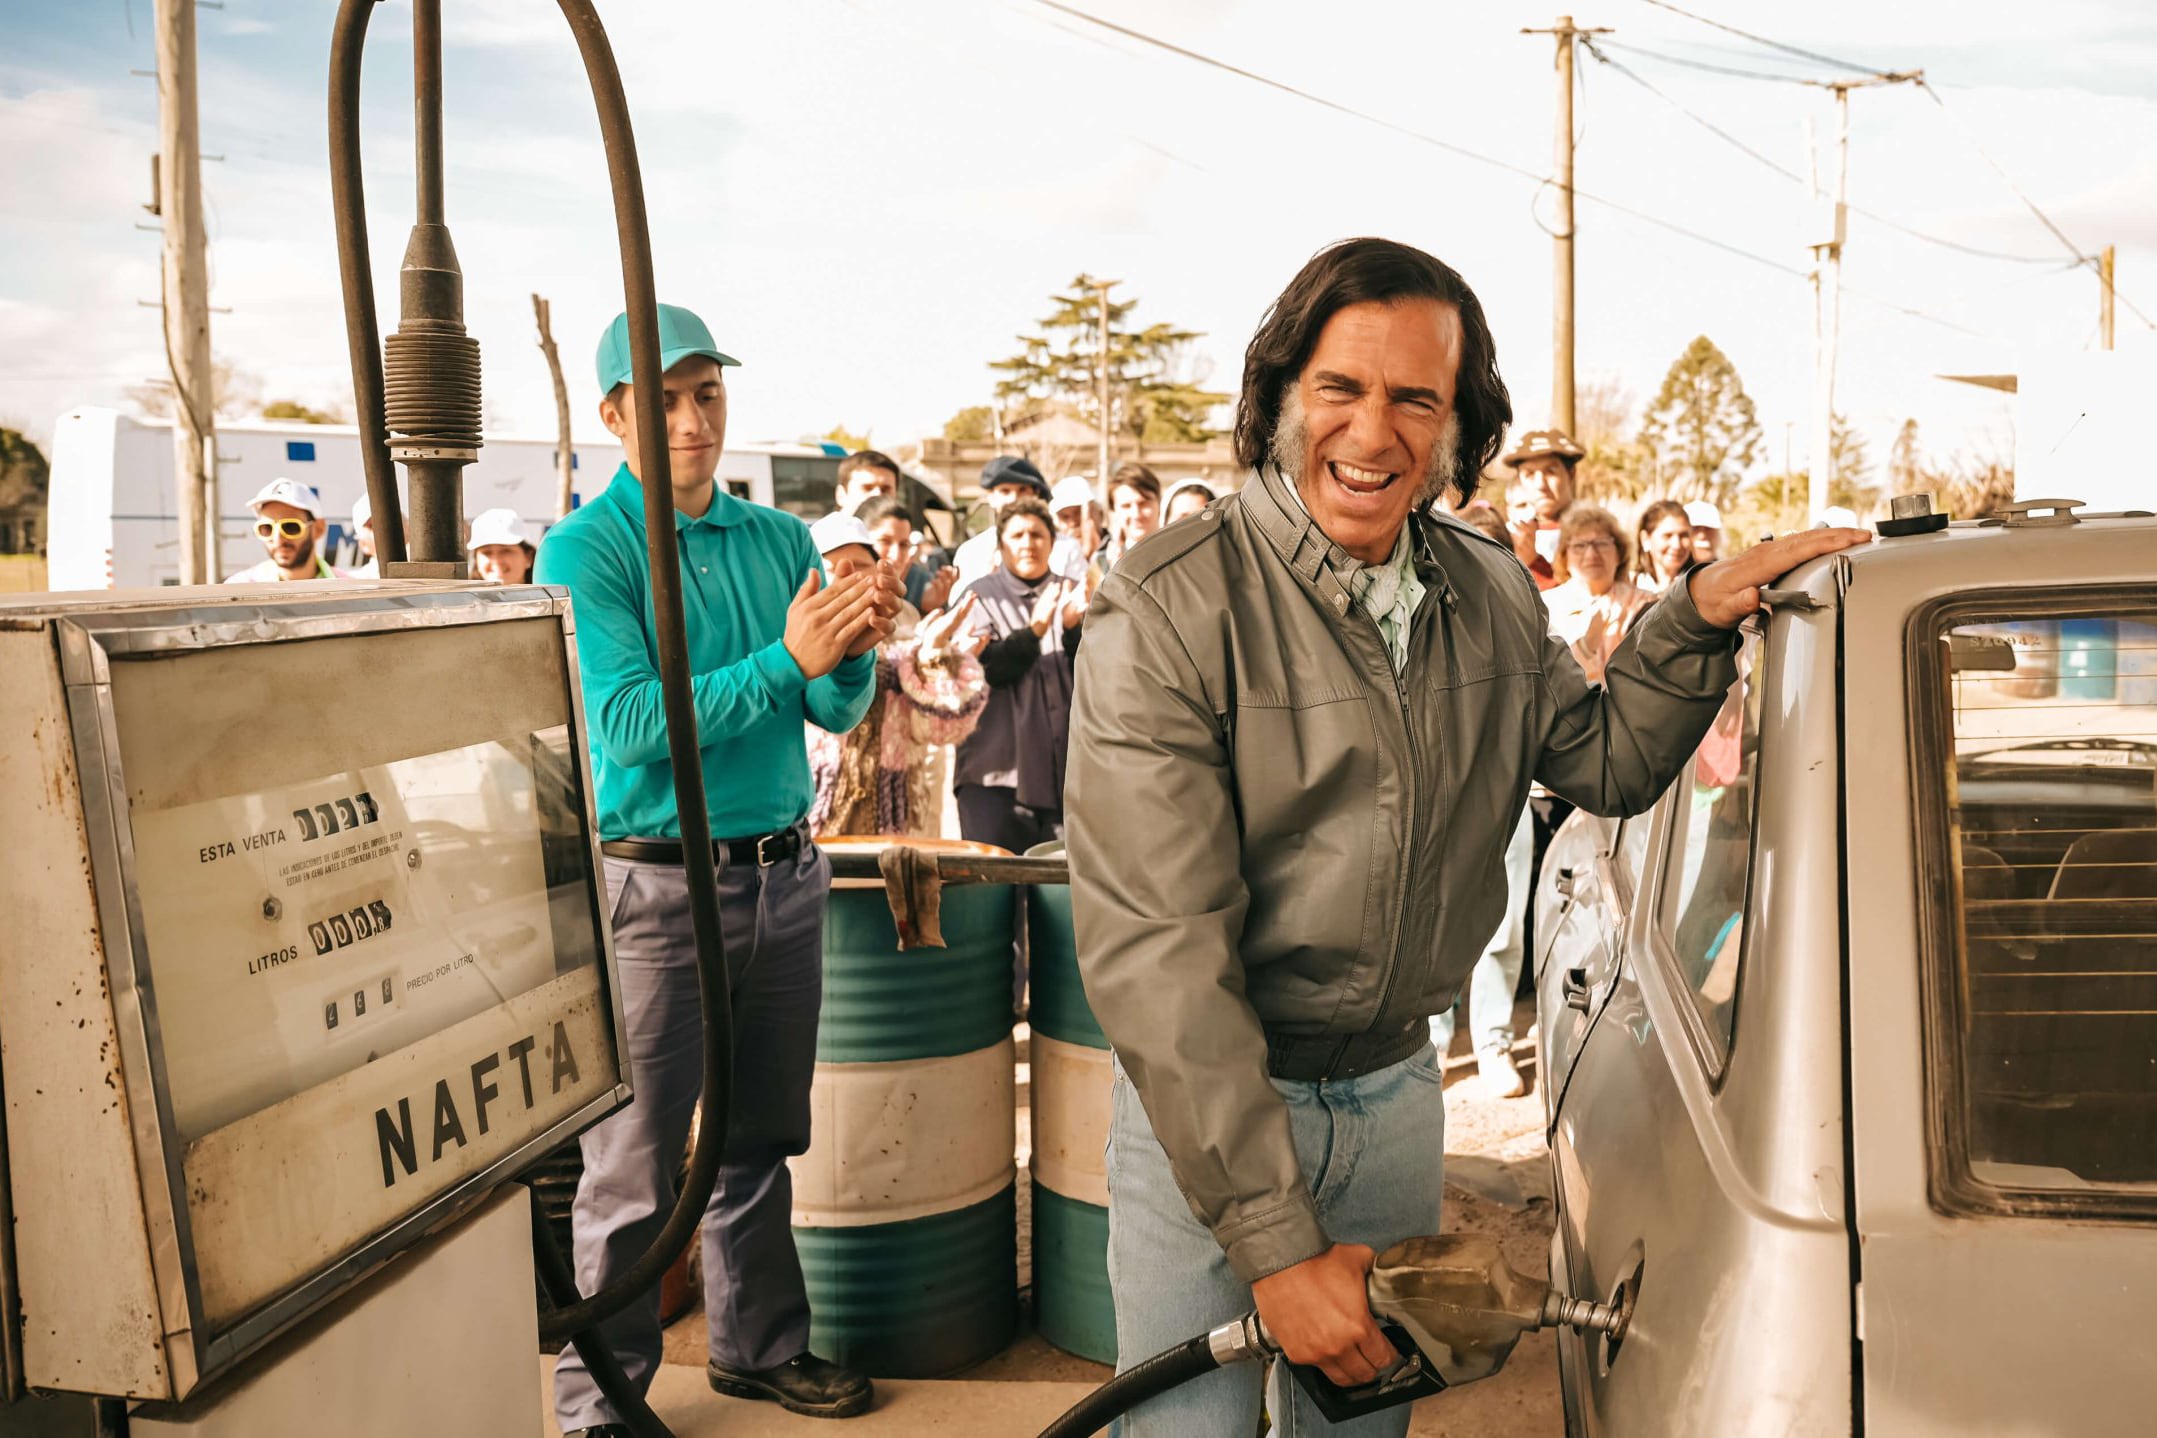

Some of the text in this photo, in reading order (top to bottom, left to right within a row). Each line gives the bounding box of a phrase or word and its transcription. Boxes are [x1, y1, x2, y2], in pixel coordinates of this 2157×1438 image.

[200, 841, 236, 863] ESTA
[242, 829, 286, 852] VENTA
[303, 872, 310, 881] EN
[324, 862, 340, 875] ANTES
[341, 859, 348, 869] DE
[371, 851, 378, 860] EL
[248, 945, 298, 975] LITROS
[406, 972, 434, 991] PRECIO
[435, 963, 451, 978] POR
[453, 953, 474, 970] LITRO
[375, 1020, 580, 1188] NAFTA
